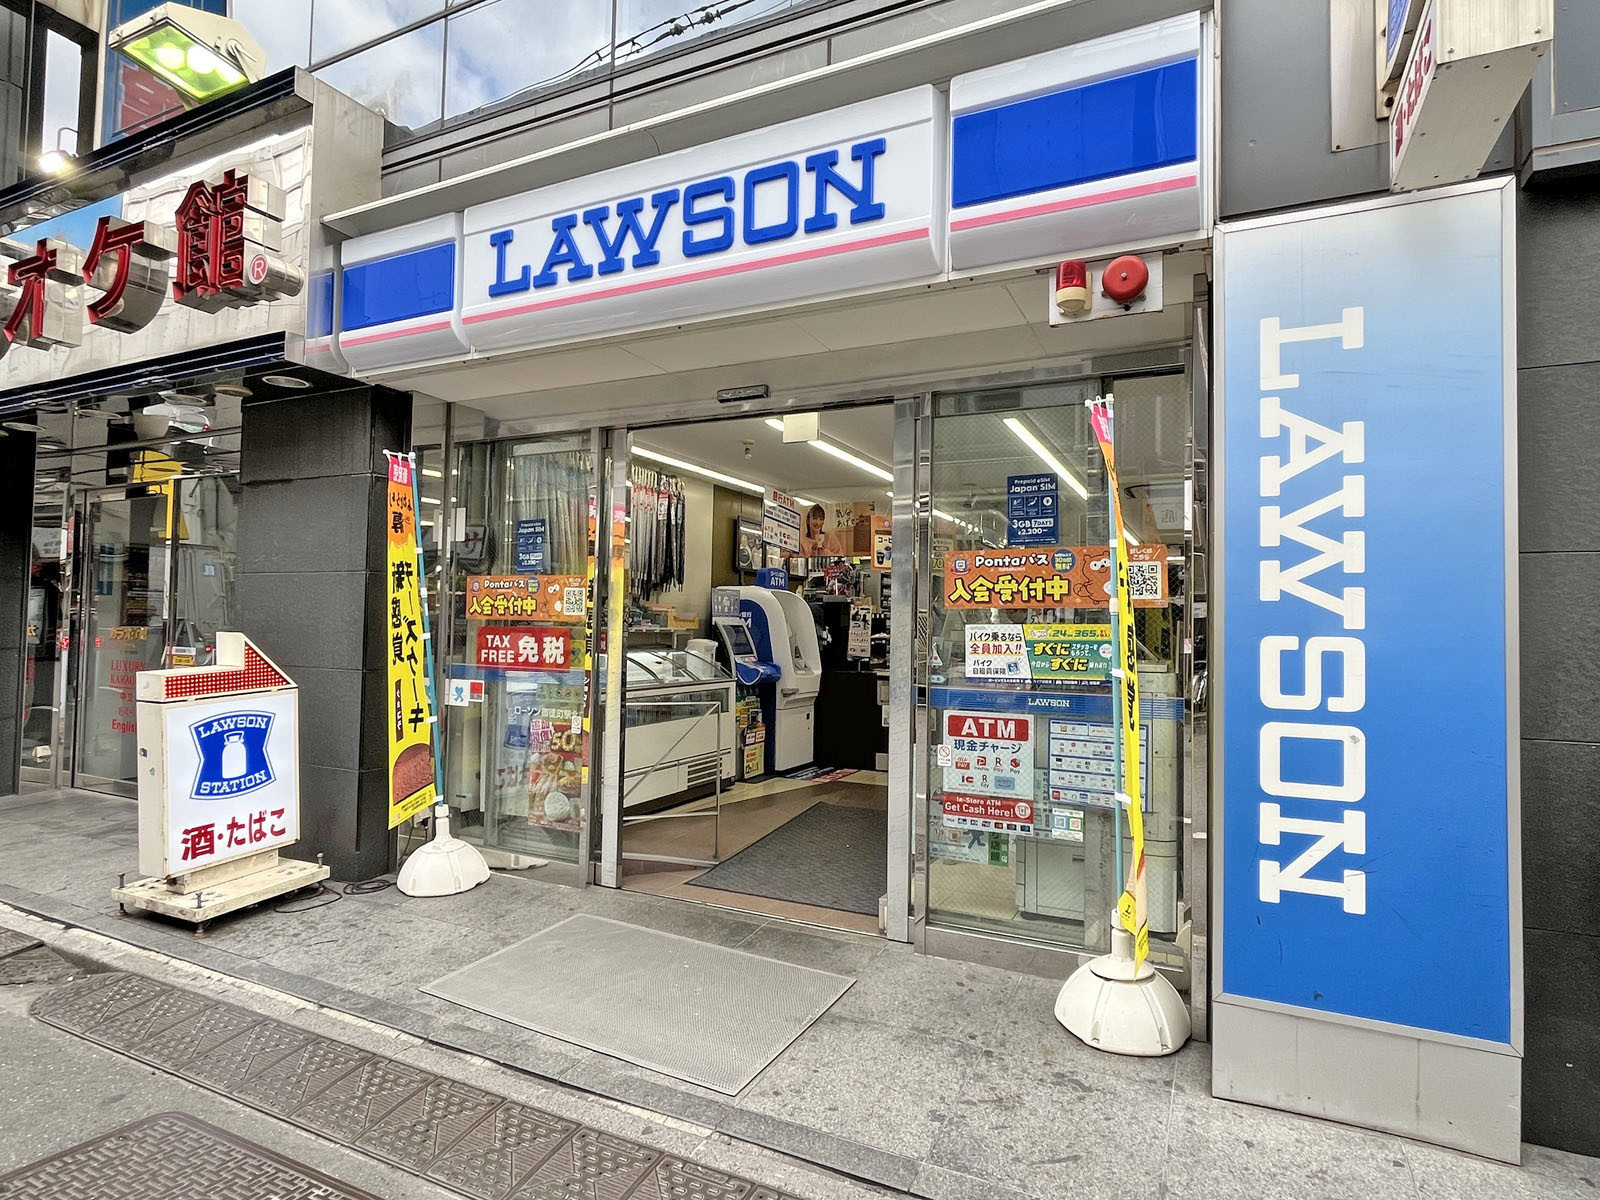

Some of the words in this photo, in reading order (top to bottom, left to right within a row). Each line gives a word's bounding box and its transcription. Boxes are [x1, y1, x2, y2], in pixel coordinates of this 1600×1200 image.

[489, 137, 887, 297] LAWSON
[1010, 485, 1038, 494] Japan
[1040, 483, 1056, 491] SIM
[1012, 519, 1031, 528] 3GB
[975, 554, 1049, 567] Pontaパス
[484, 579, 525, 589] Pontaパス
[770, 577, 785, 587] ATM
[949, 575, 1069, 602] 入会受付中
[469, 595, 537, 616] 入会受付中
[1259, 306, 1366, 915] LAWSON
[486, 634, 511, 648] TAX
[970, 631, 1022, 642] バイク乗るなら
[481, 649, 515, 663] FREE
[517, 635, 565, 665] 免税
[970, 643, 1022, 655] 全員加入!!
[1033, 642, 1070, 656] すぐに
[973, 659, 993, 667] バイク
[1050, 657, 1088, 671] すぐに
[1027, 698, 1070, 708] LAWSON
[515, 706, 540, 716] ローソン
[112, 719, 137, 733] Englis
[197, 715, 269, 739] LAWSON
[961, 717, 1016, 739] ATM
[953, 739, 1022, 754] 現金チャージ
[199, 769, 268, 796] STATION
[956, 796, 984, 806] In-Store
[986, 799, 1002, 807] ATM
[945, 802, 961, 812] Get
[963, 804, 985, 815] Cash
[987, 807, 1014, 818] Here!
[181, 808, 287, 861] 酒・たばこ
